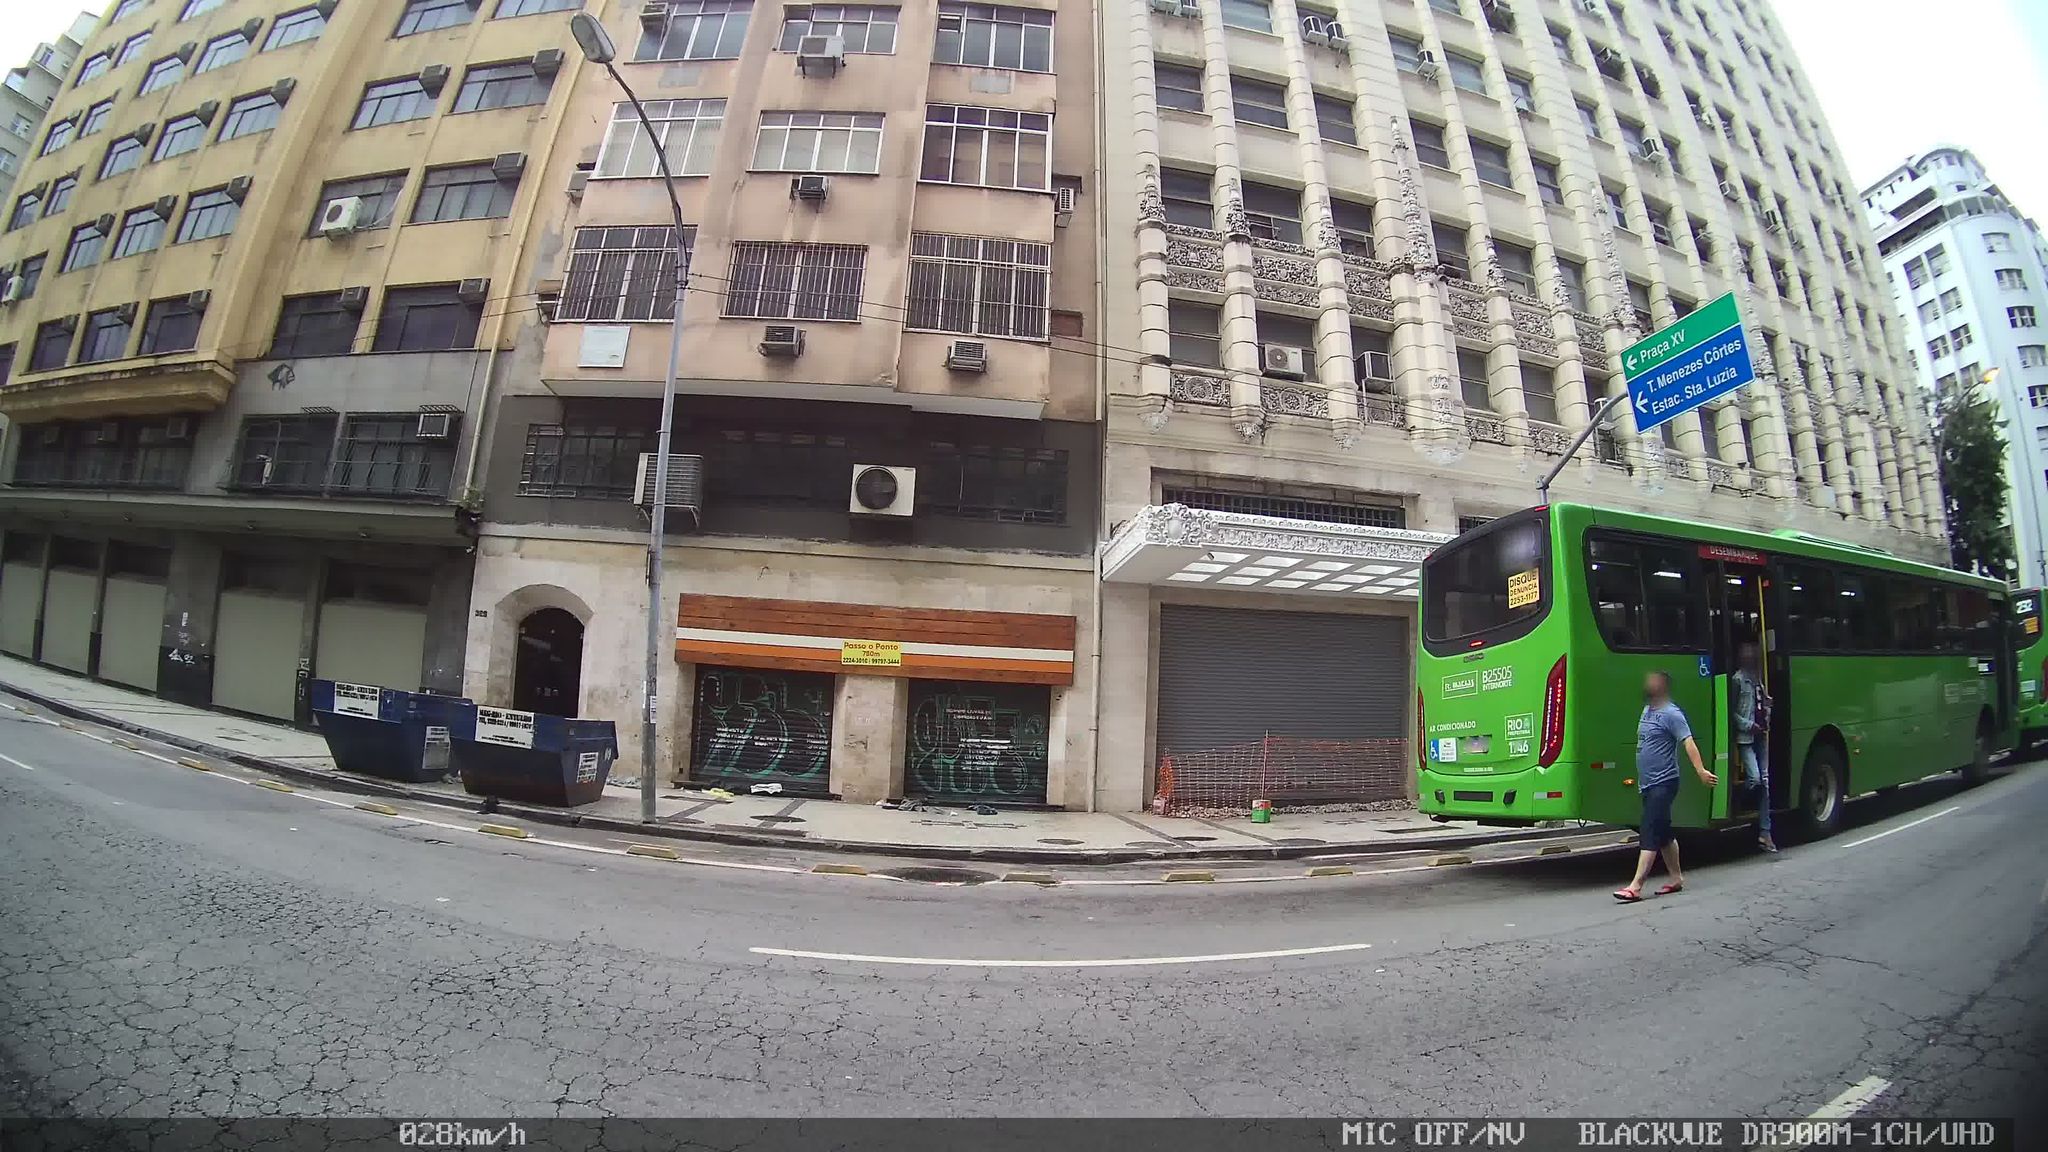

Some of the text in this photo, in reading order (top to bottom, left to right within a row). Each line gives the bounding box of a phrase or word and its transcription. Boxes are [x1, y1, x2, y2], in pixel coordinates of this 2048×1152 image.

[1640, 329, 1686, 363] Praça XV
[1646, 339, 1742, 393] T. Menezes Côrtes
[1651, 367, 1738, 415] Estac. Sta. Luzia
[1510, 571, 1537, 588] DISQUE
[844, 642, 867, 650] Passo
[876, 643, 899, 651] Ponto
[1482, 665, 1513, 684] B25505
[1430, 720, 1477, 733] AR CONDICIONADO
[1507, 718, 1523, 731] RIO
